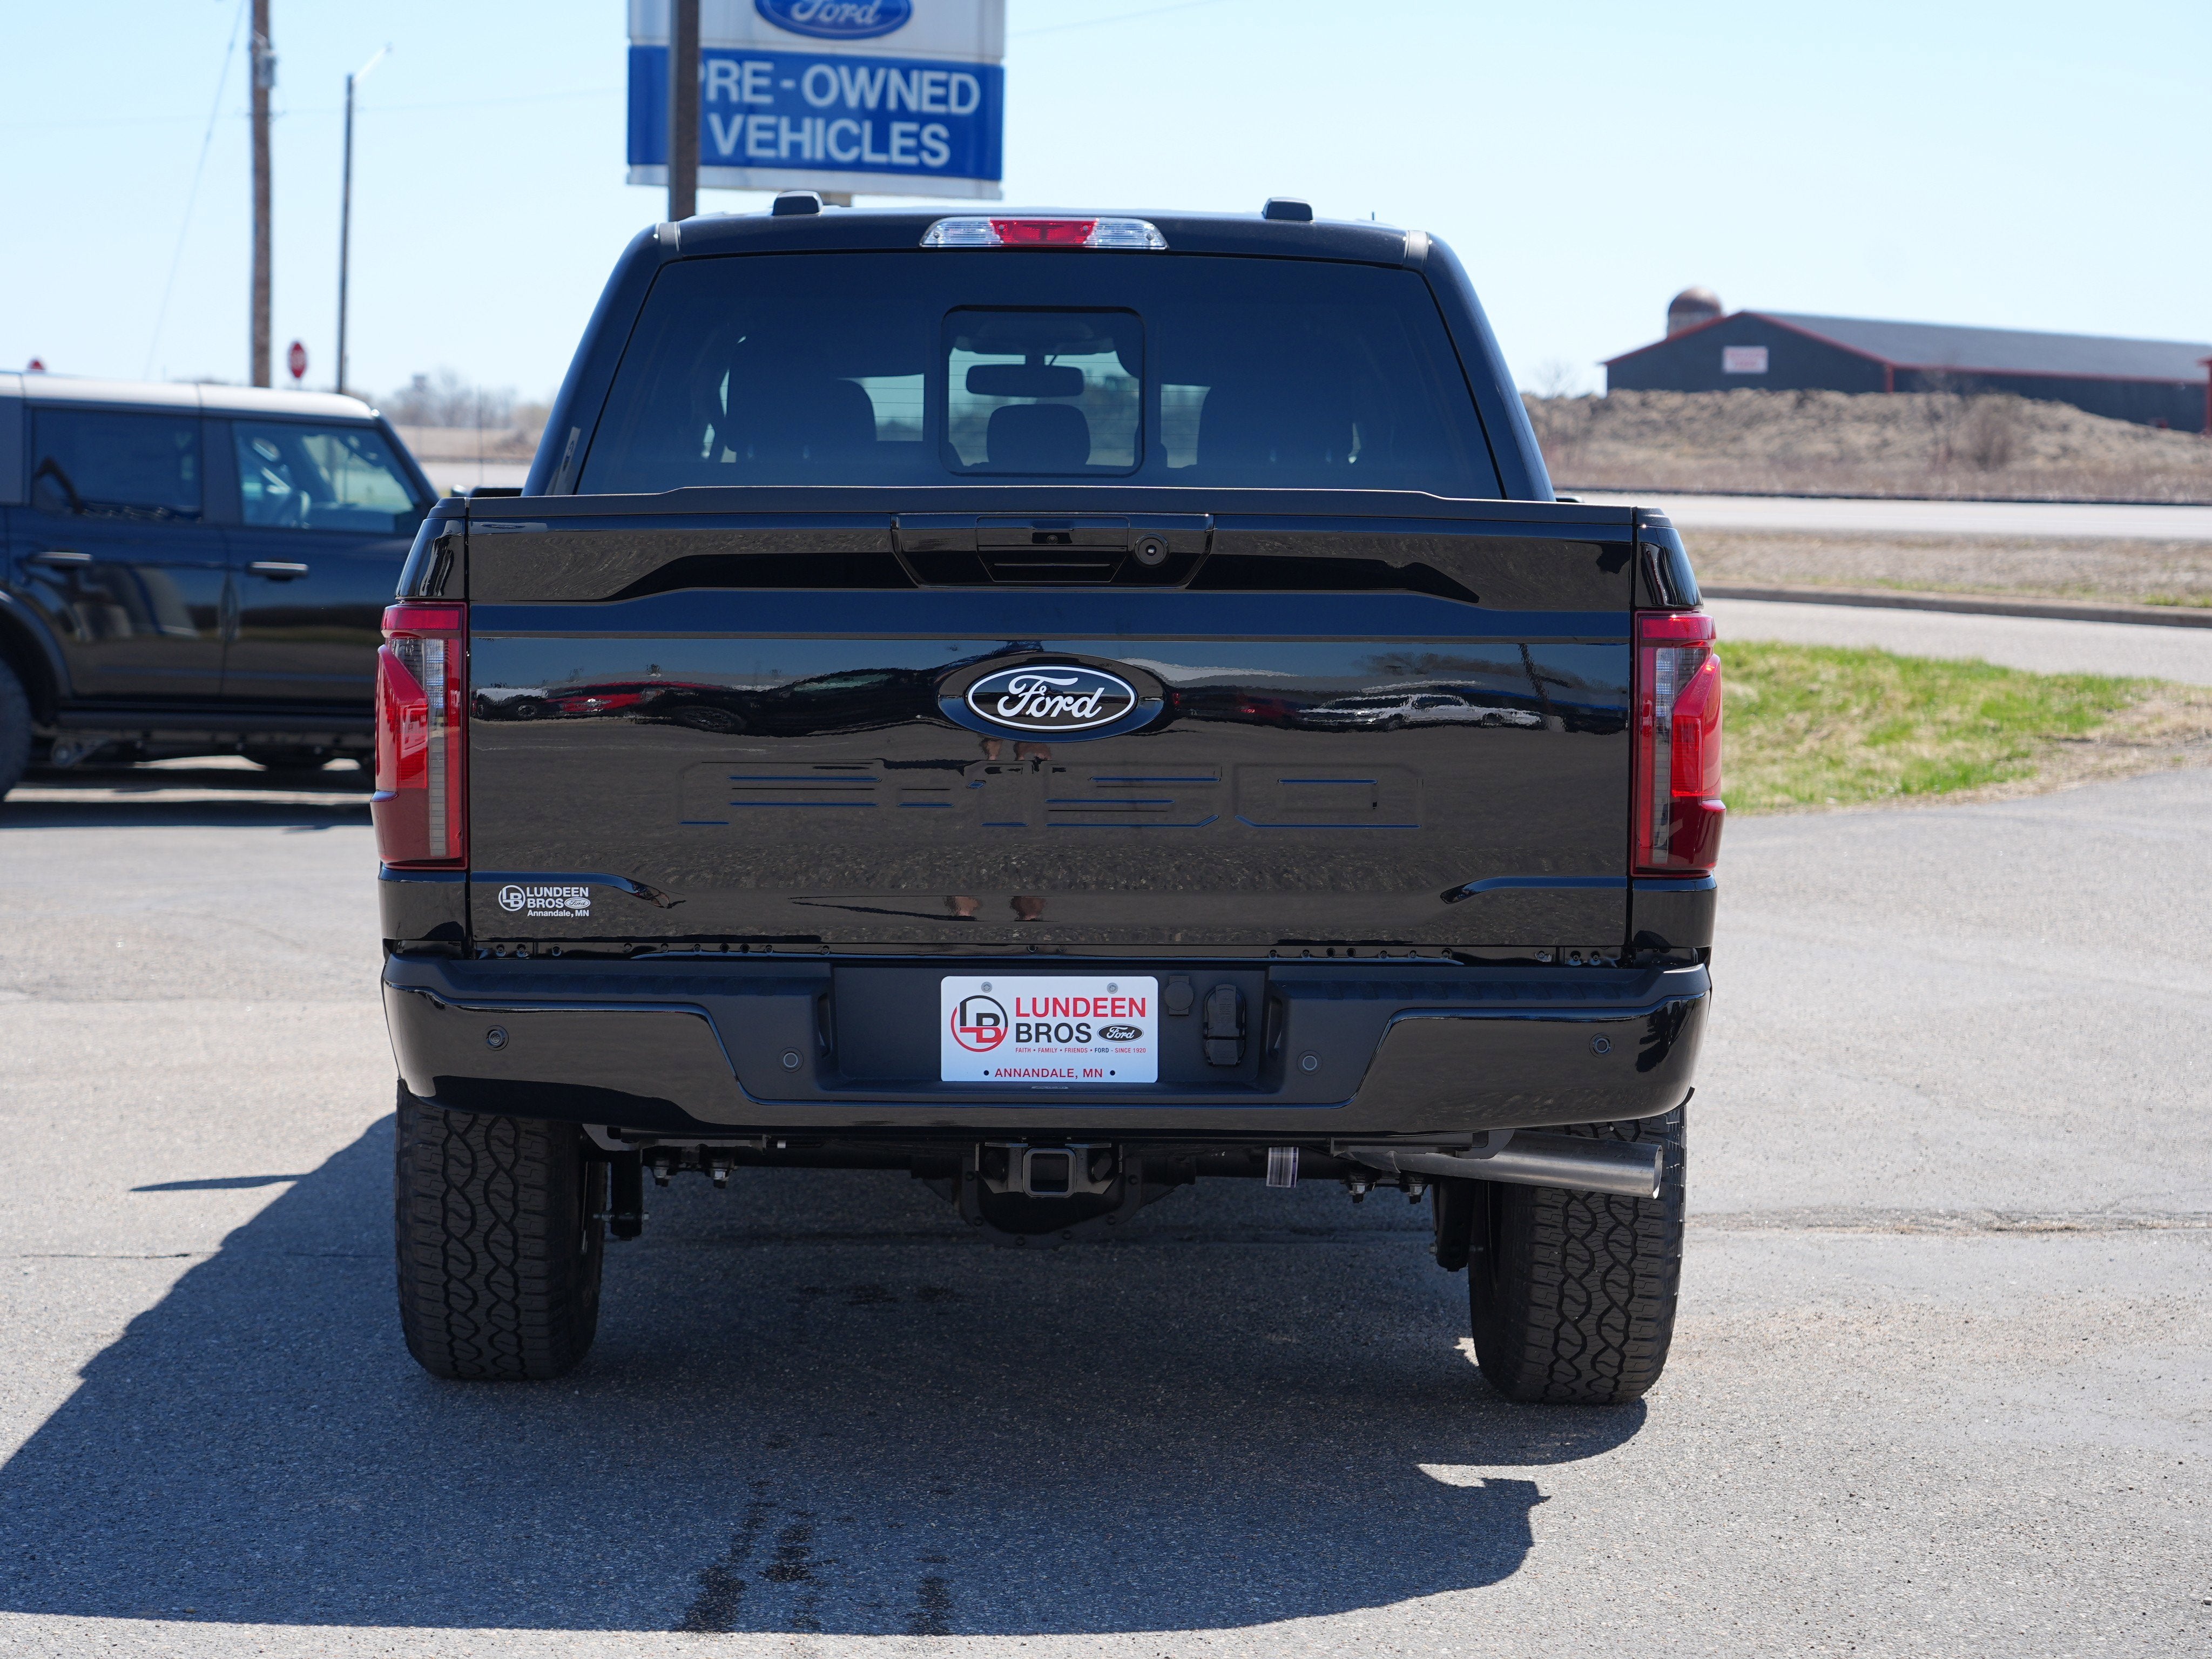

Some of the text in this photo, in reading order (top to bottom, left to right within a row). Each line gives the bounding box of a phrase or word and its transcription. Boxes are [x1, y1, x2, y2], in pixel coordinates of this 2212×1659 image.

[707, 113, 950, 167] VEHICLES
[997, 675, 1105, 718] Ford
[526, 887, 589, 897] LUNDEEN
[527, 898, 564, 908] BROS
[527, 909, 574, 918] Annandale,
[1015, 997, 1146, 1017] LUNDEEN
[1015, 1022, 1092, 1043] BROS
[994, 1068, 1103, 1080] ANNANDALE, MN
